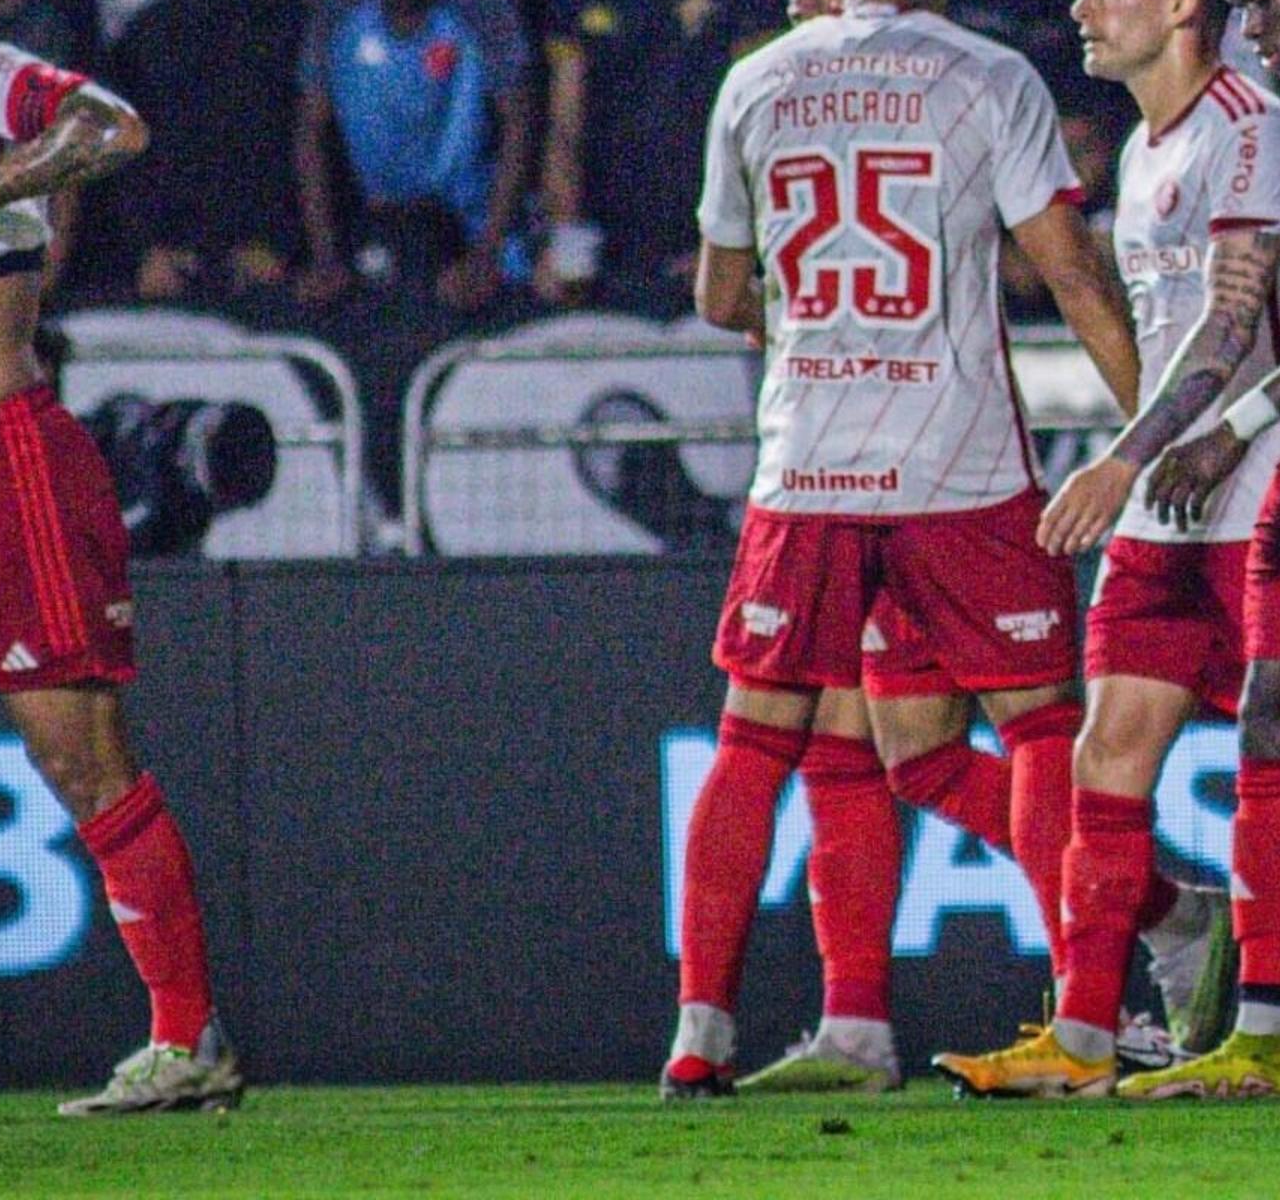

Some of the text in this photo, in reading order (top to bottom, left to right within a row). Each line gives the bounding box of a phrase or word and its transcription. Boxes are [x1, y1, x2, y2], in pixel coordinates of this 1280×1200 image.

[805, 52, 944, 79] banrisul
[774, 90, 923, 131] MERCADO
[1230, 124, 1260, 193] vero
[766, 147, 936, 323] 25
[887, 359, 939, 382] BET
[782, 466, 898, 491] Unimed
